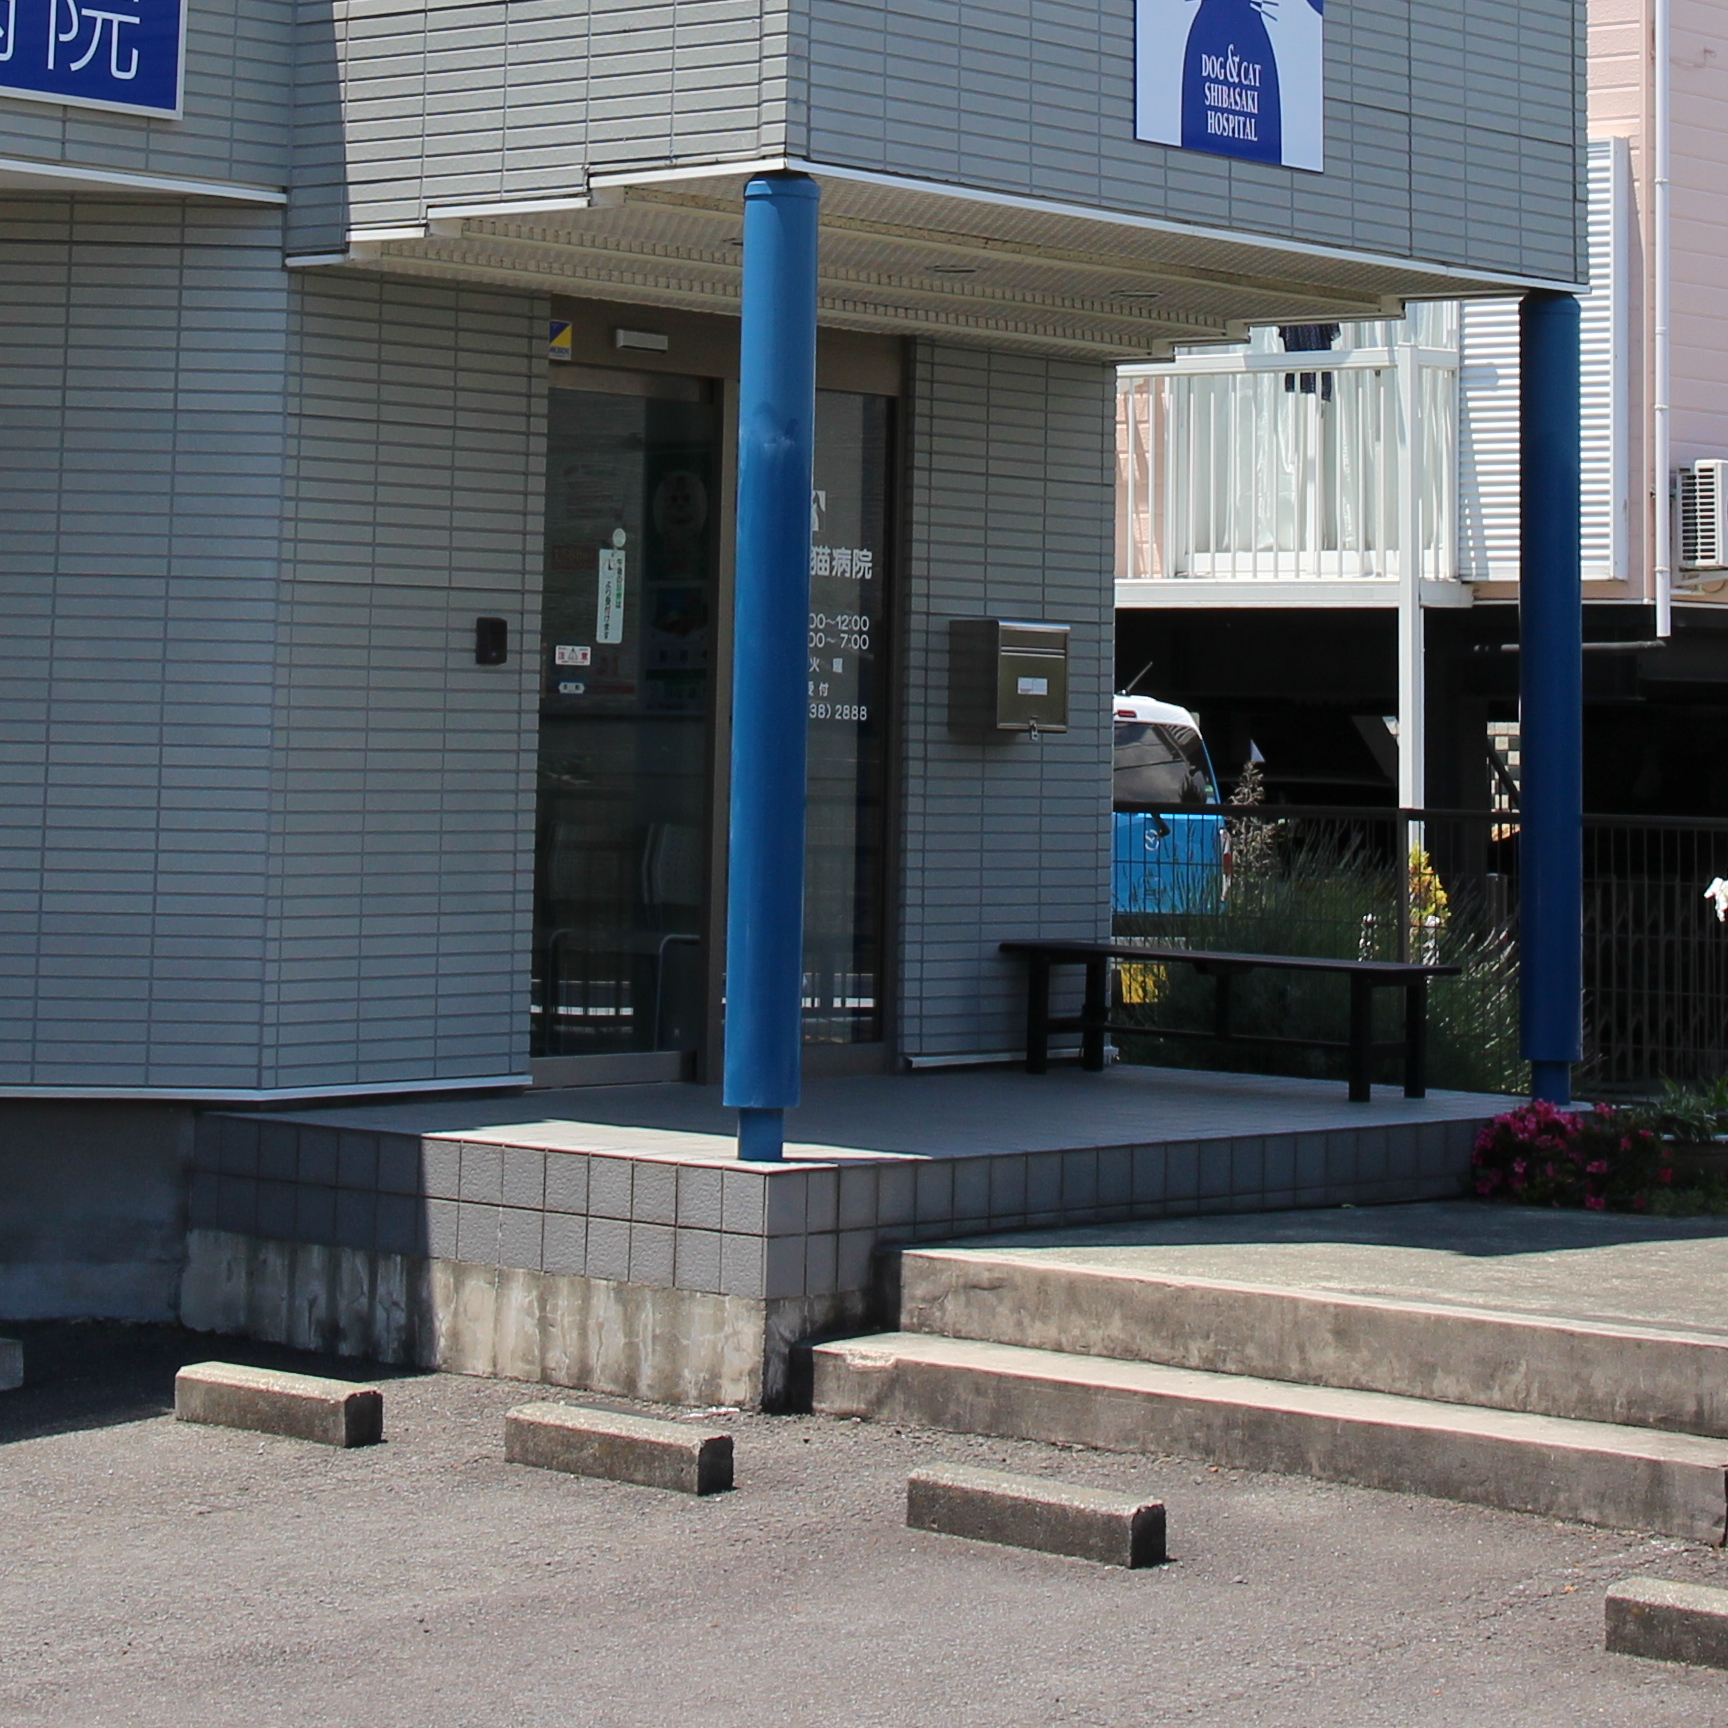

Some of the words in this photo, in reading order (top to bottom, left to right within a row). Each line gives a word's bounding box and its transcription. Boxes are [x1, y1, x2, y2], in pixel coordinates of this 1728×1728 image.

[1201, 53, 1225, 81] DOG
[1226, 43, 1240, 84] &
[1240, 60, 1261, 87] CAT
[1204, 81, 1259, 115] SHIBASAKI
[1207, 110, 1259, 142] HOSPITAL
